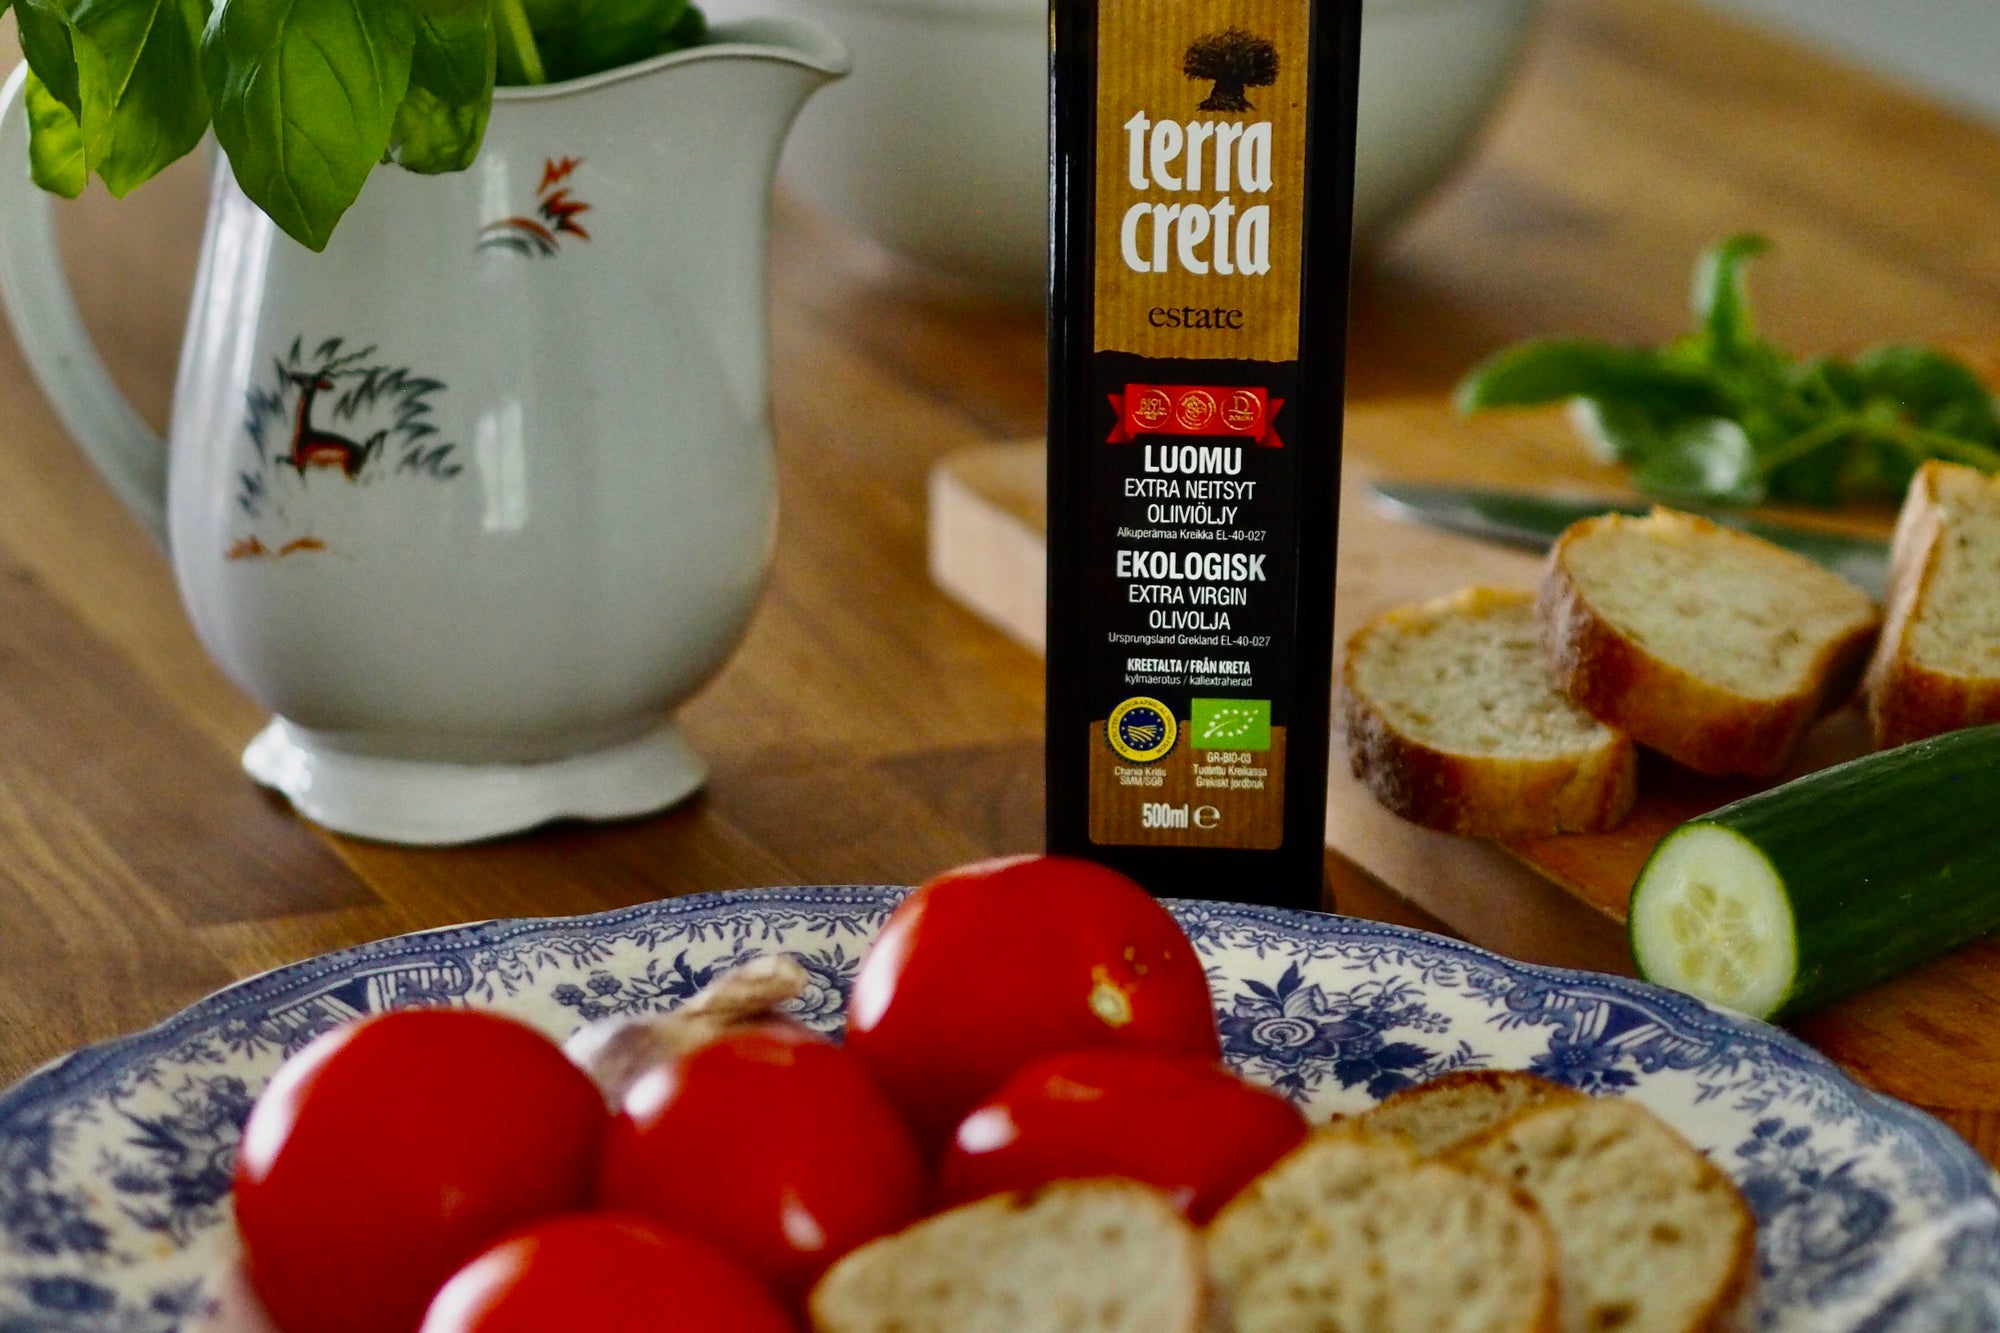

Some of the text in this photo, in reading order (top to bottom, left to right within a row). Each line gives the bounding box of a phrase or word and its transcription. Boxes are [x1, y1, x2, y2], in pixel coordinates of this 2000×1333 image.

[1124, 110, 1273, 193] terra
[1121, 196, 1271, 276] creta
[1149, 306, 1243, 329] estate
[1144, 445, 1242, 475] LUOMU
[1125, 478, 1256, 500] EXTRA NEITSYT
[1147, 502, 1238, 525] OLIIVIÖLJY
[1117, 527, 1266, 541] Alkuperämaa Kreikka EL-40-027
[1116, 550, 1266, 581] EKOLOGISK
[1129, 584, 1247, 606] EXTRA VIRGIN
[1150, 610, 1231, 630] OLIVOLJA
[1108, 632, 1271, 646] Ursprungsland Grekland EL-40-027
[1127, 658, 1183, 673] KREETALTA
[1190, 657, 1218, 674] FRÅN
[1218, 661, 1251, 674] KRETA
[1142, 803, 1189, 828] 500ml
